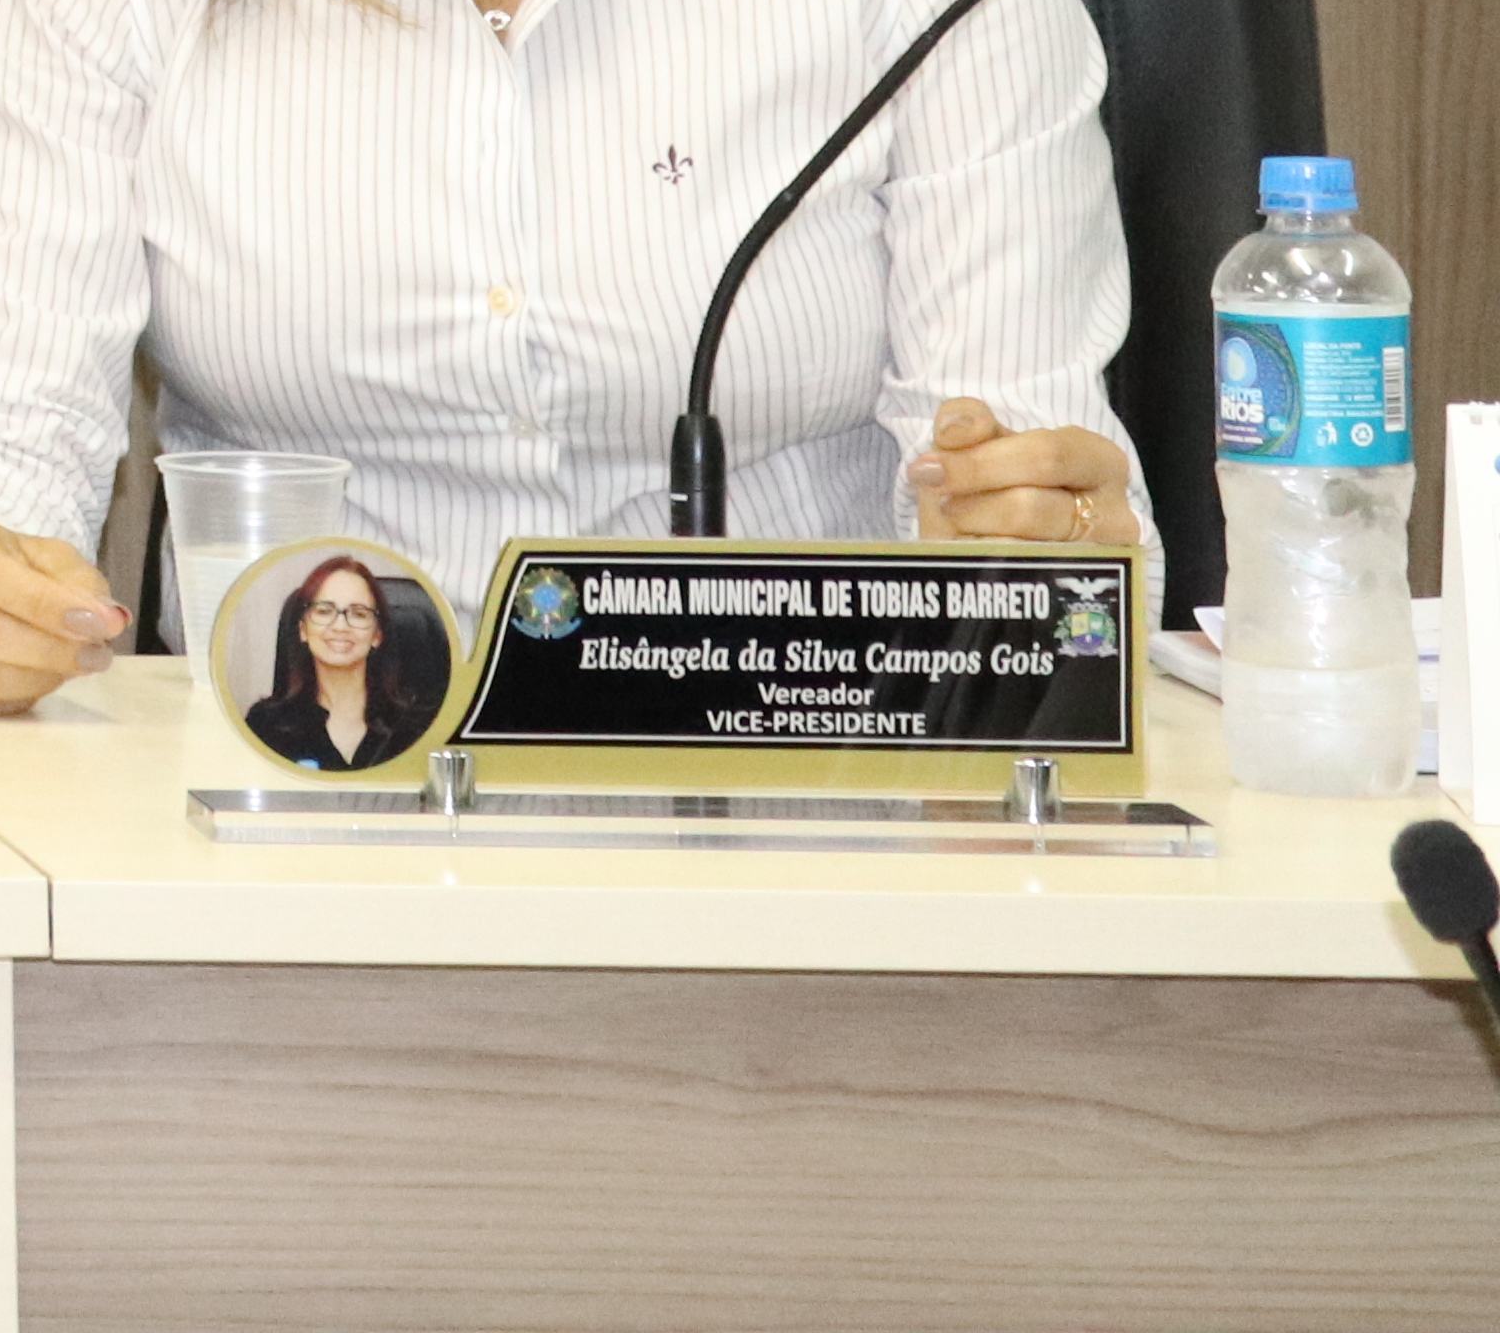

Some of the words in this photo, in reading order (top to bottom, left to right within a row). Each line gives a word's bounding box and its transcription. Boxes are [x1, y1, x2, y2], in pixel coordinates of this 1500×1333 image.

[583, 571, 682, 616] CÂMARA
[687, 577, 817, 617] MUNICIPAL
[821, 579, 853, 618] DE
[856, 579, 941, 620] TOBIAS
[945, 581, 1050, 621] BARRETO
[579, 637, 729, 679] Elisângela
[737, 640, 777, 672] da
[785, 641, 858, 674] Silva
[865, 643, 981, 683] Campos
[989, 643, 1053, 677] Gois
[758, 683, 873, 707] Vereador
[707, 709, 926, 735] VICE-PRESIDENTE
